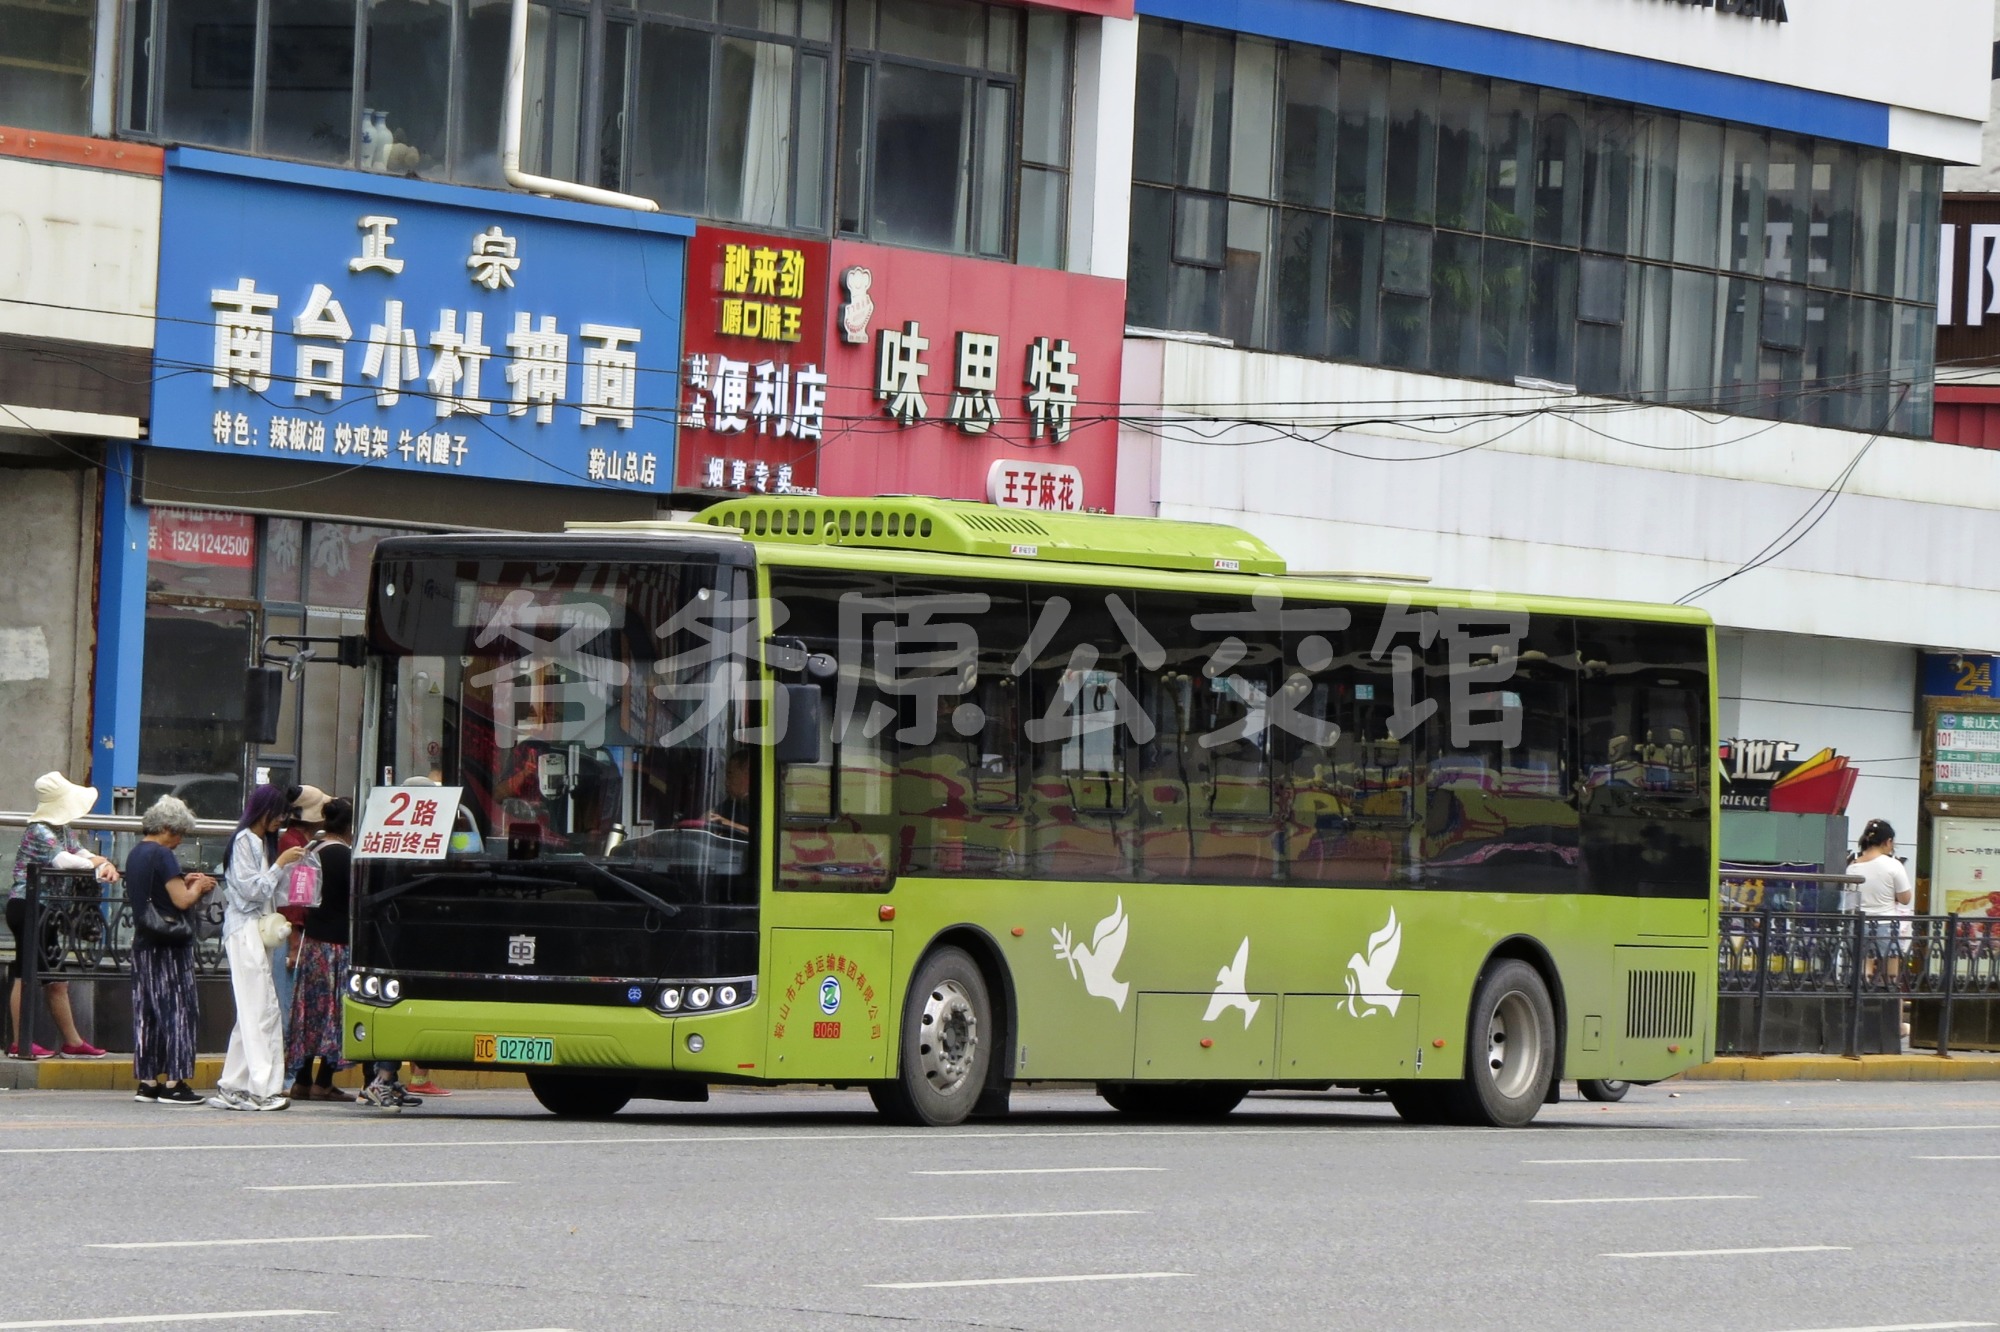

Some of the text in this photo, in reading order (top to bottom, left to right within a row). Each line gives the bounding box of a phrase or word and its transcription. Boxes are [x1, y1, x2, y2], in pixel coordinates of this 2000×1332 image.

[348, 214, 521, 290] 正宗
[723, 243, 806, 299] 秒来劲
[722, 299, 802, 342] 嚼口味王
[711, 355, 828, 440] 便利店
[875, 320, 1080, 443] 味思特
[270, 415, 325, 453] 辣椒油
[334, 422, 389, 458] 炒鸡架
[396, 429, 469, 466] 牛肉腱子
[588, 448, 657, 485] 鞍山总店
[708, 457, 793, 493] 烟草专卖
[1003, 471, 1075, 511] 王子麻花
[171, 530, 250, 557] 15241242500
[1954, 661, 1993, 692] 24
[1937, 732, 1952, 747] 101
[1961, 716, 2000, 730] 鞍山大
[383, 791, 439, 828] 2路
[361, 831, 443, 855] 站前终点
[773, 953, 881, 1040] 鞍山市交通运输集团有限公司
[814, 1022, 840, 1038] 3066
